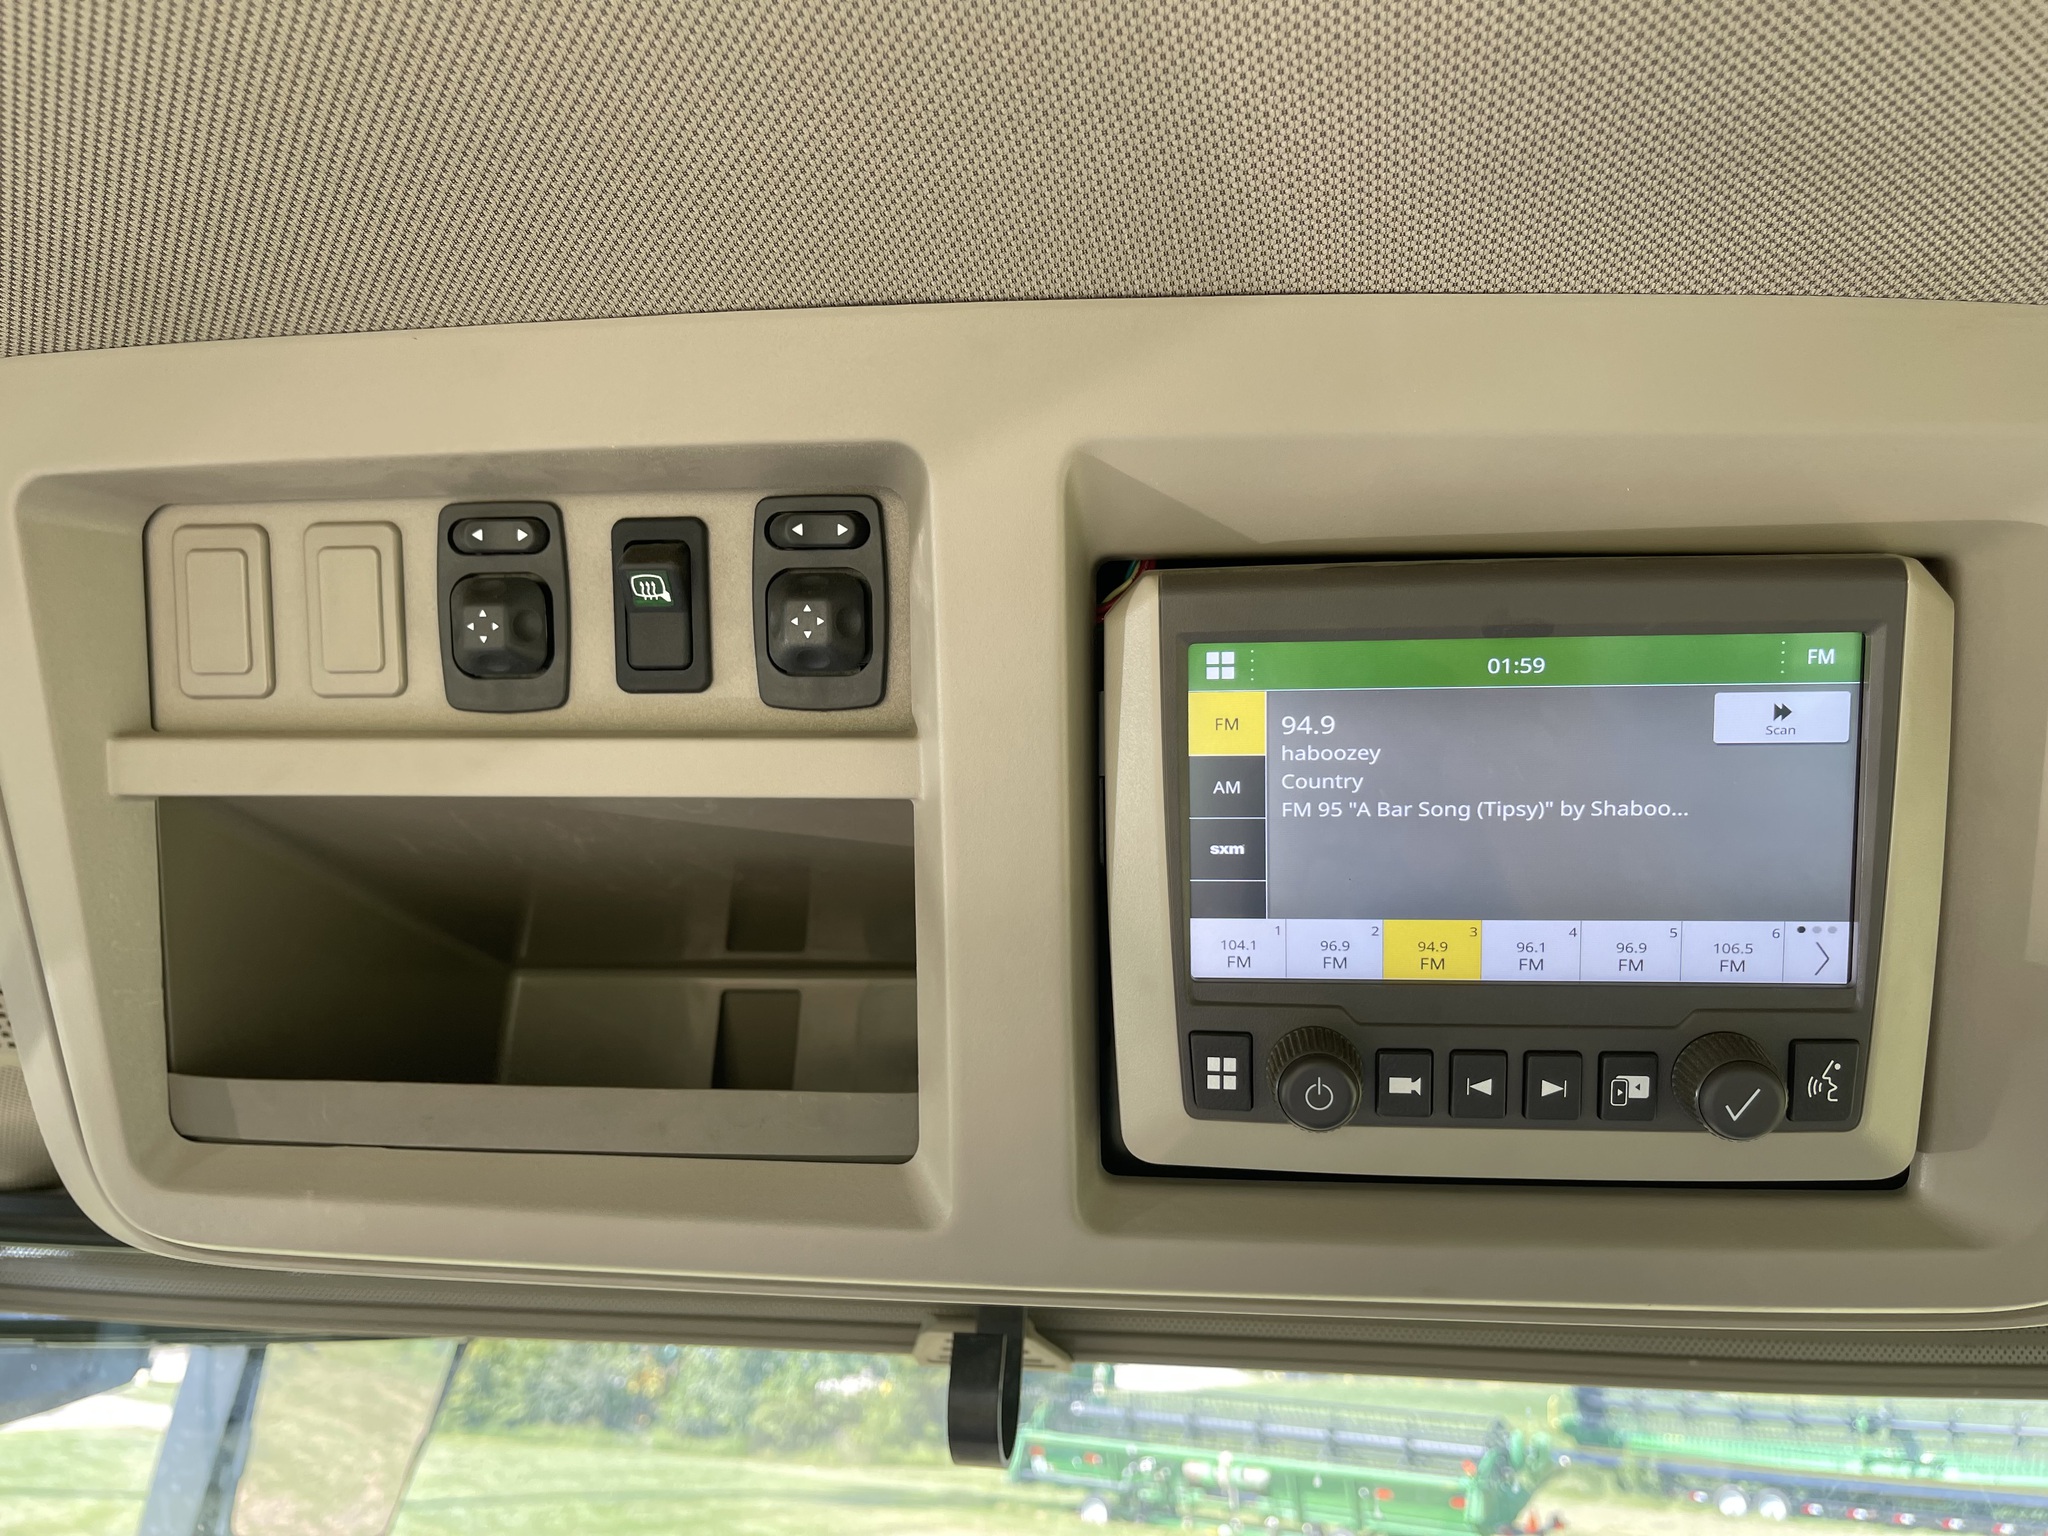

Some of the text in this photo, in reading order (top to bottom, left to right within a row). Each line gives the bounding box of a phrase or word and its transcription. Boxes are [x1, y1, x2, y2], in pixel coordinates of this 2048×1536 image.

[1807, 648, 1835, 665] FM
[1487, 657, 1546, 674] 01:59
[1215, 717, 1239, 731] FM
[1281, 715, 1336, 735] 94.9
[1765, 725, 1796, 736] Scan
[1281, 745, 1381, 765] haboozey
[1212, 781, 1241, 794] AM
[1281, 773, 1364, 793] Country
[1282, 800, 1689, 822] FM 95 "A Bar Song (Tipsy)" by Shaboo...
[1209, 844, 1245, 855] sxm
[1274, 925, 1281, 936] 1
[1371, 926, 1380, 937] 2
[1469, 927, 1478, 938] 3
[1568, 927, 1578, 938] 4
[1669, 928, 1678, 939] 5
[1772, 929, 1781, 940] 6
[1220, 939, 1257, 951] 104.1
[1320, 940, 1350, 952] 96.9
[1417, 941, 1449, 953] 94.9
[1516, 942, 1546, 953] 96.1
[1616, 942, 1647, 954] 96.9
[1713, 943, 1754, 954] 106.5
[1226, 956, 1252, 968] FM
[1322, 956, 1348, 970] FM
[1420, 958, 1445, 970] FM
[1518, 958, 1544, 971] FM
[1618, 959, 1644, 972] FM
[1719, 960, 1746, 973] FM
